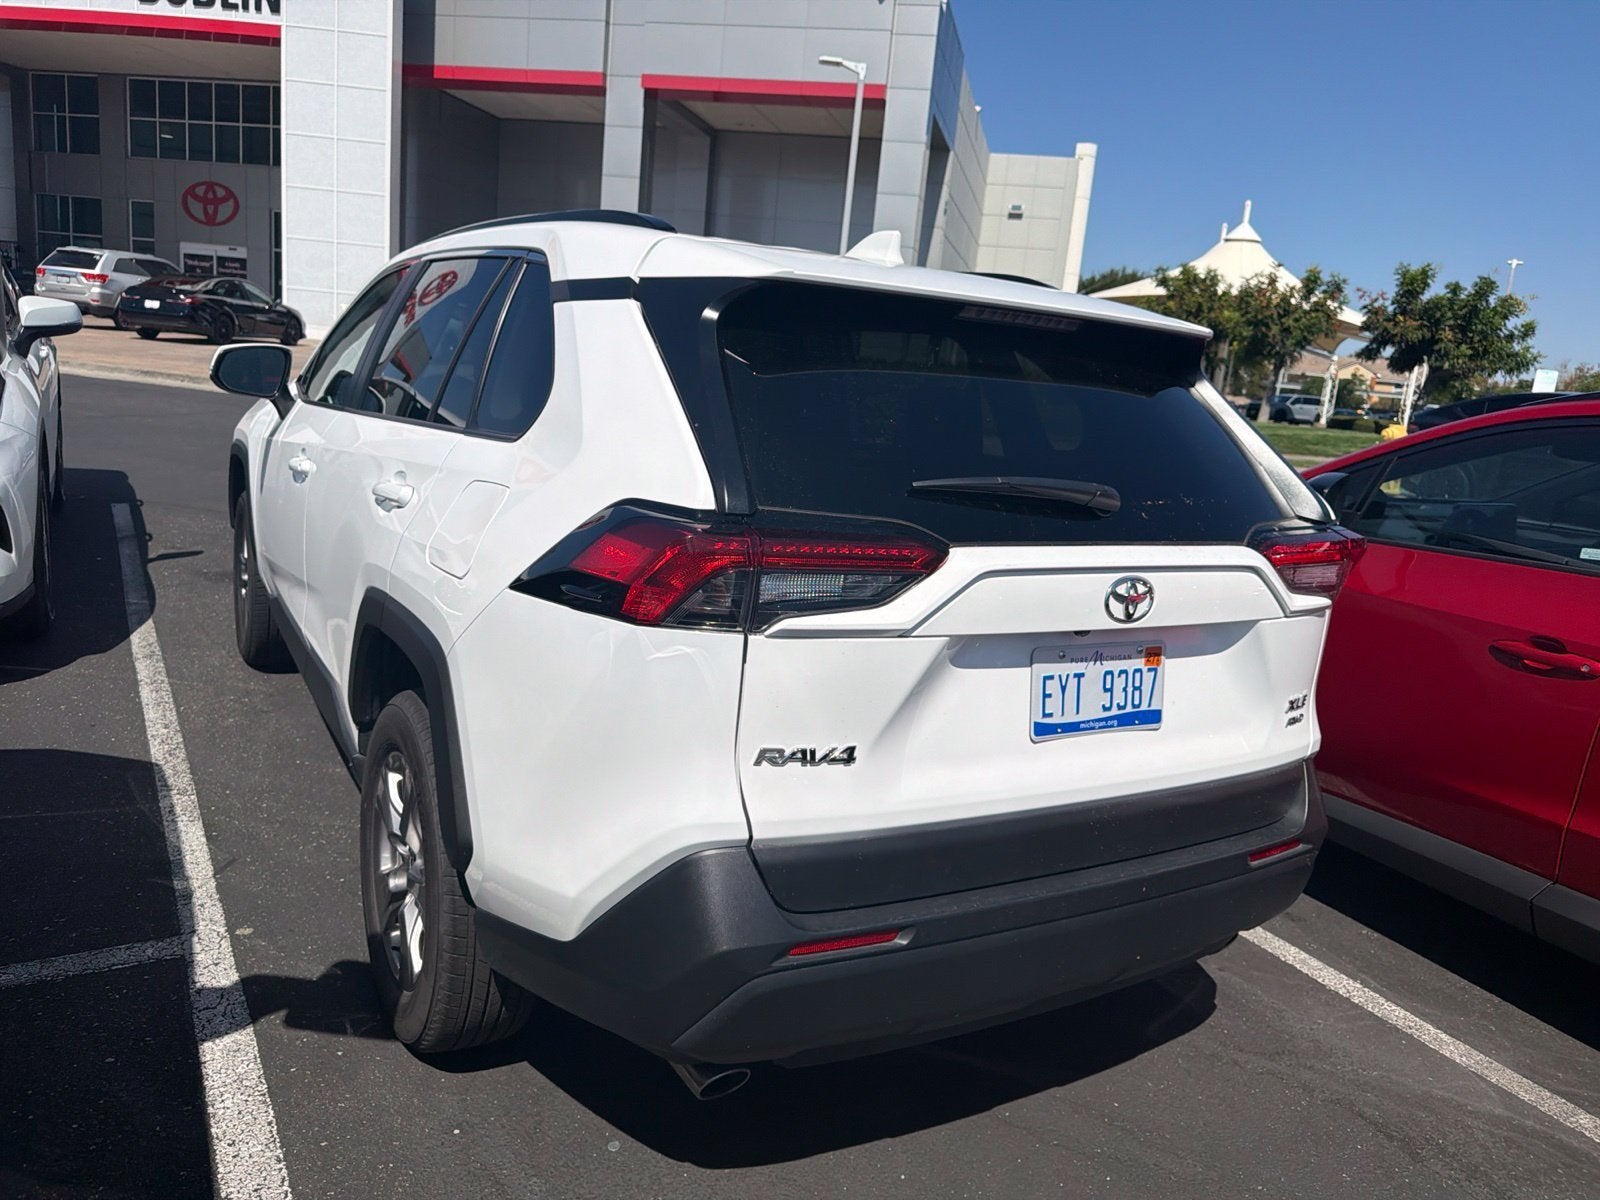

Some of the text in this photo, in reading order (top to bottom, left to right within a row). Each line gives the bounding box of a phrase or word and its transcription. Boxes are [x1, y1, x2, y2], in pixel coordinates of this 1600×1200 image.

[1070, 656, 1089, 664] PURE
[1041, 667, 1159, 719] EYT 9387
[1285, 694, 1308, 714] XLE
[1080, 720, 1118, 729] michigan.org
[753, 745, 857, 767] RAV4
